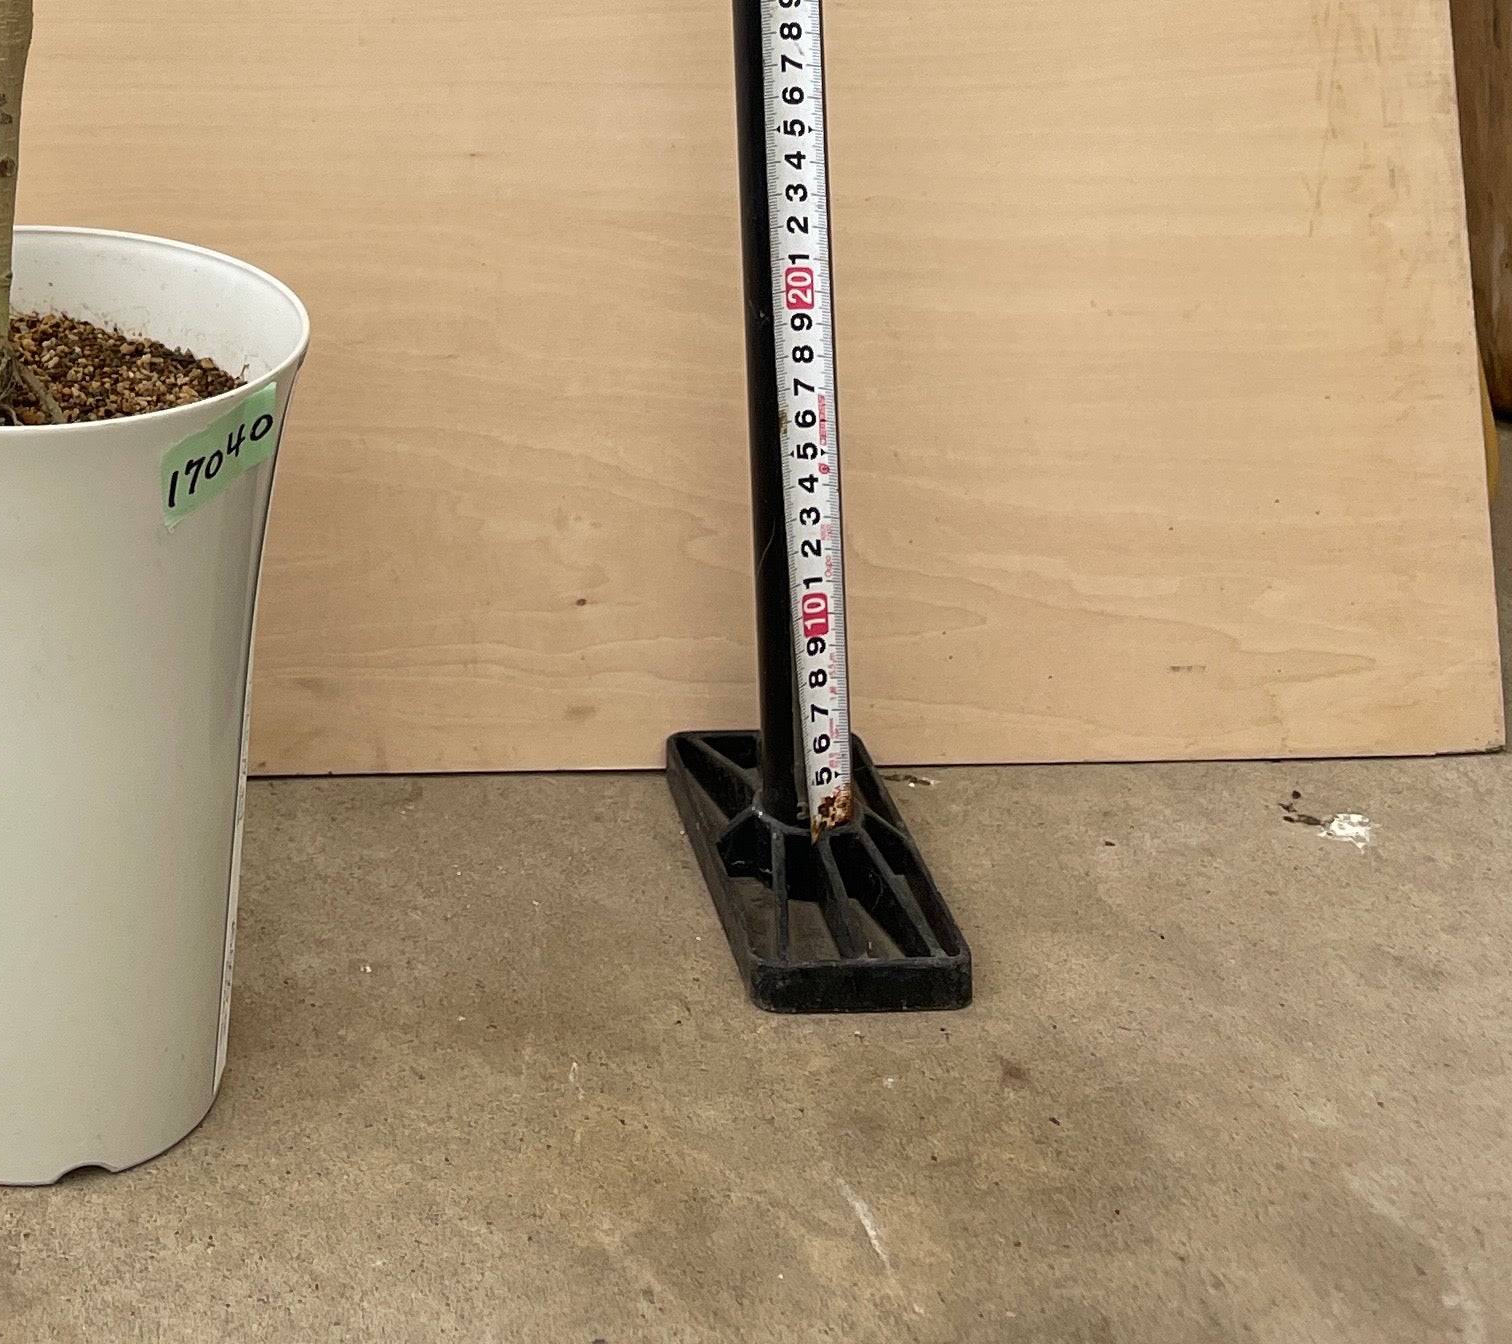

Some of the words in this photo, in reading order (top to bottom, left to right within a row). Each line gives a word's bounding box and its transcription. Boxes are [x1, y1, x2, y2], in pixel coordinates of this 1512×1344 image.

[779, 21, 803, 41] 8
[780, 54, 803, 73] 7
[781, 86, 805, 105] 6
[782, 119, 806, 137] 5
[784, 150, 806, 170] 4
[785, 183, 808, 202] 3
[786, 215, 809, 235] 2
[787, 254, 810, 265] 1
[787, 269, 812, 306] 20
[790, 312, 813, 332] 9
[791, 344, 814, 364] 8
[793, 377, 815, 397] 7
[794, 409, 817, 428] 6
[167, 414, 274, 509] 17040
[796, 442, 818, 461] 5
[797, 473, 819, 494] 4
[799, 506, 821, 526] 3
[800, 539, 822, 558] 2
[802, 576, 823, 590] 1
[803, 596, 826, 631] 10
[806, 636, 826, 657] 9
[808, 668, 828, 689] 8
[810, 703, 829, 723] 7
[812, 733, 831, 755] 6
[815, 766, 833, 787] 5
